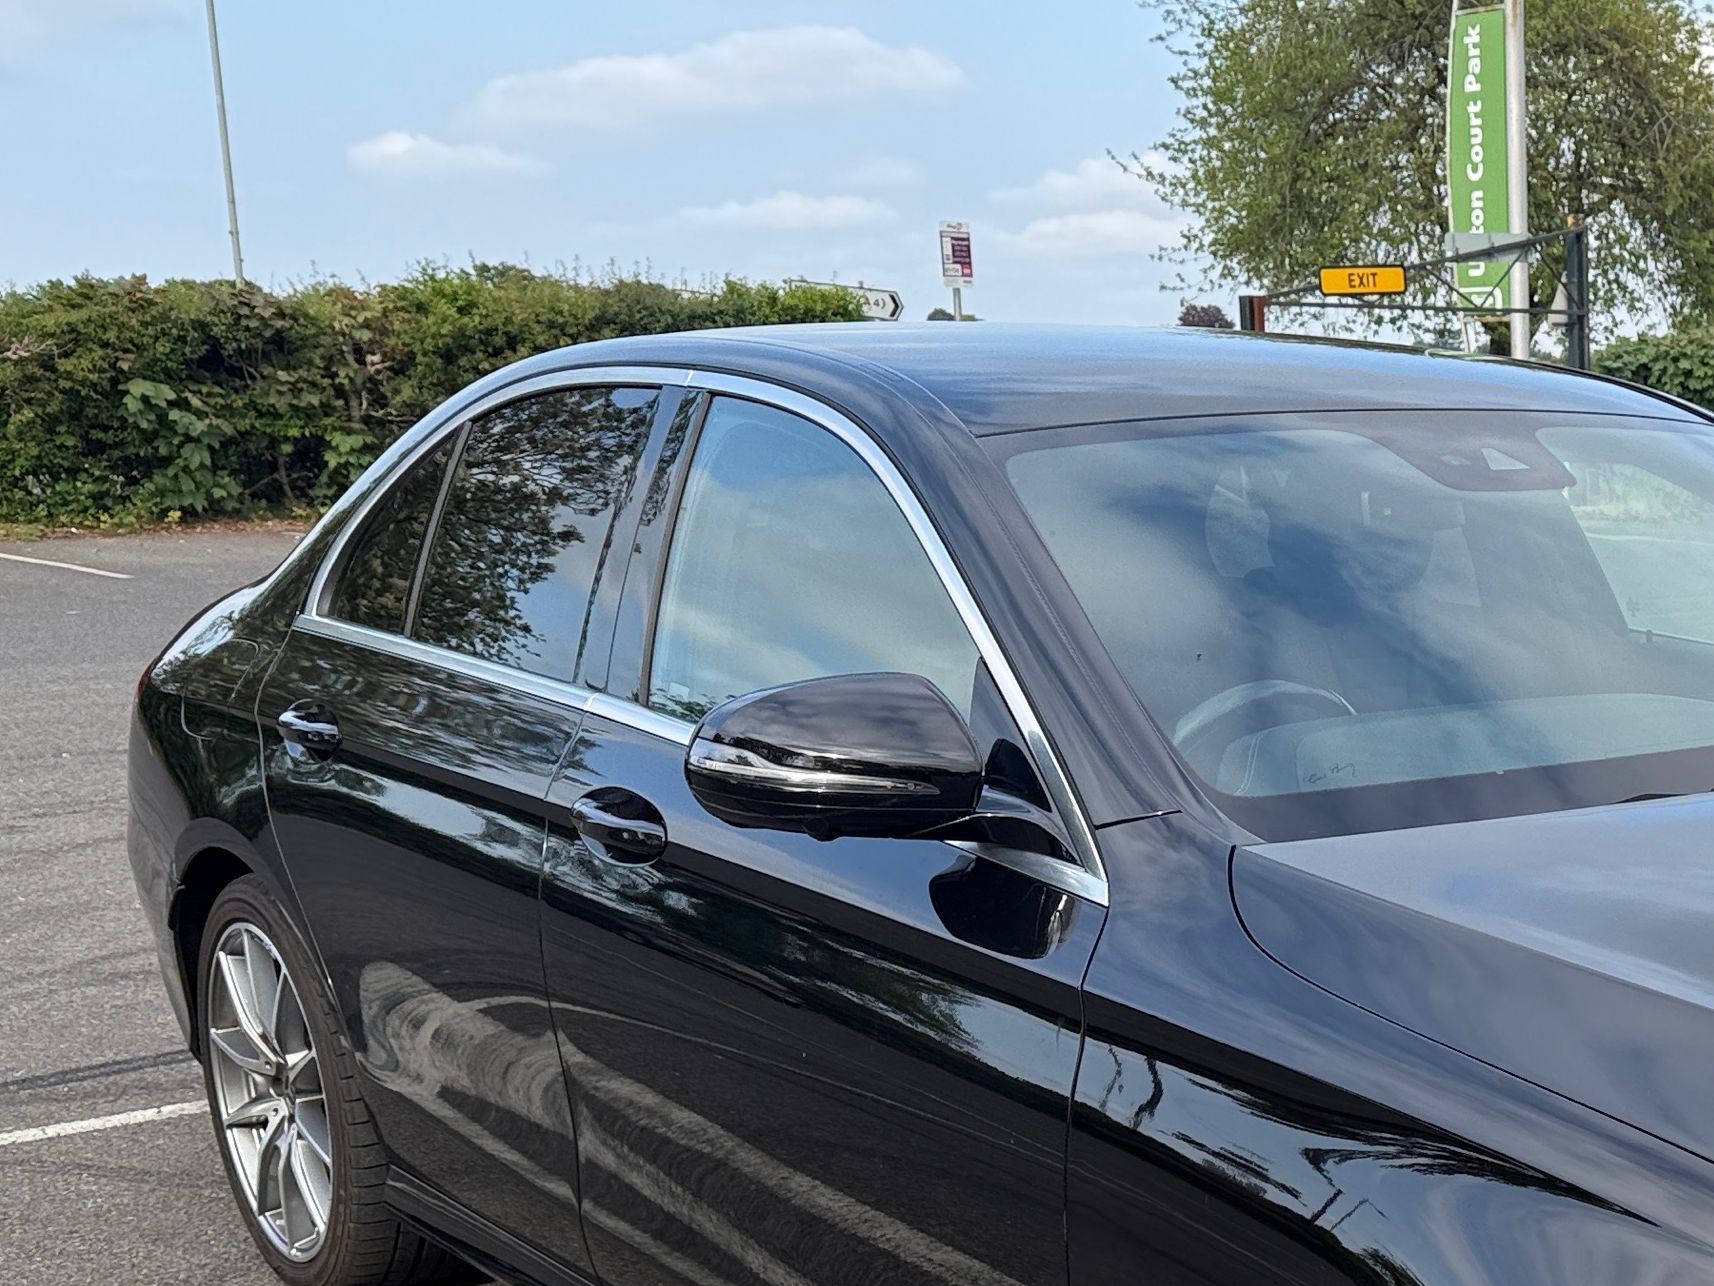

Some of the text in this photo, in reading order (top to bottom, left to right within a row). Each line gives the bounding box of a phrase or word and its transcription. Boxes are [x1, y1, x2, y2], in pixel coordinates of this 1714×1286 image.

[1463, 23, 1485, 277] Uton Court Park
[1347, 272, 1378, 289] EXIT
